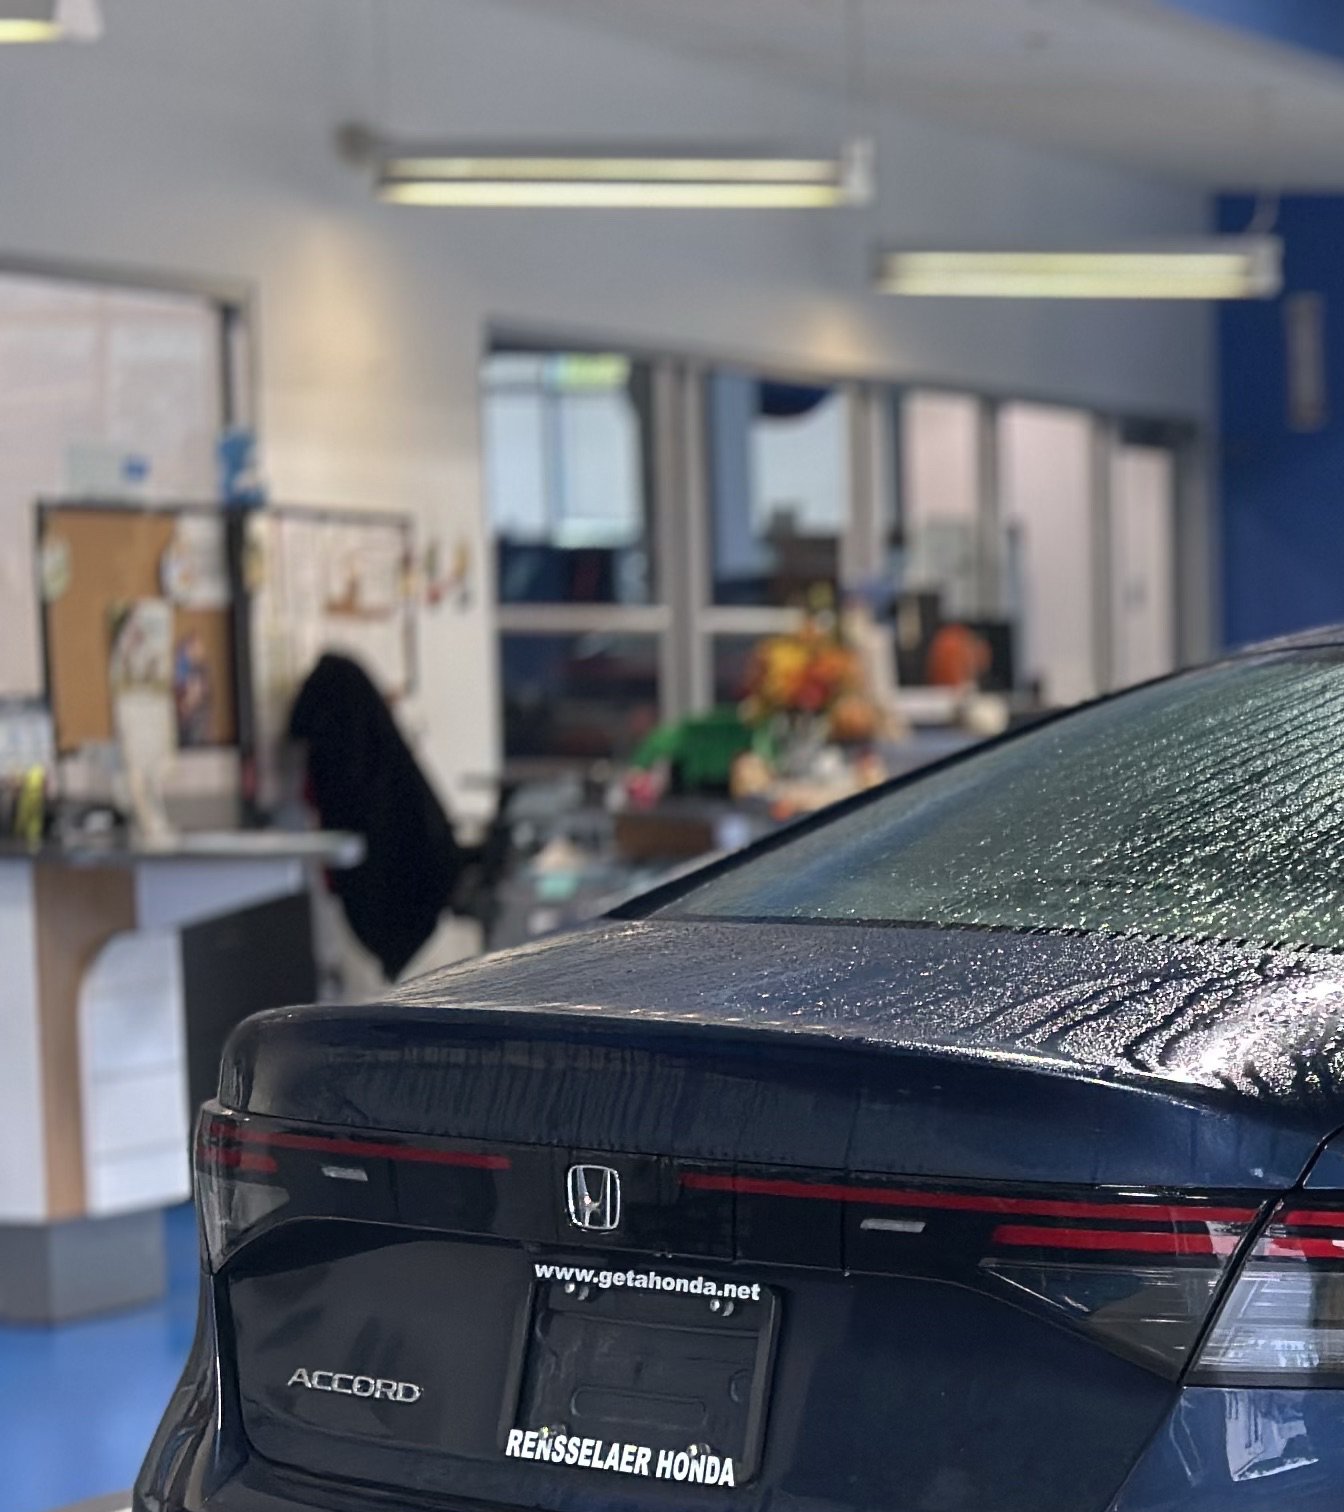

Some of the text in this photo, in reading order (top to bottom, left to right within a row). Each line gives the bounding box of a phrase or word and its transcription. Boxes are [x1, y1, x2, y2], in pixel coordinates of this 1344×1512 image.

[534, 1263, 761, 1301] www.getahonda.net
[287, 1367, 421, 1403] ACCORD
[505, 1428, 735, 1487] RENSSELAER HONDA
